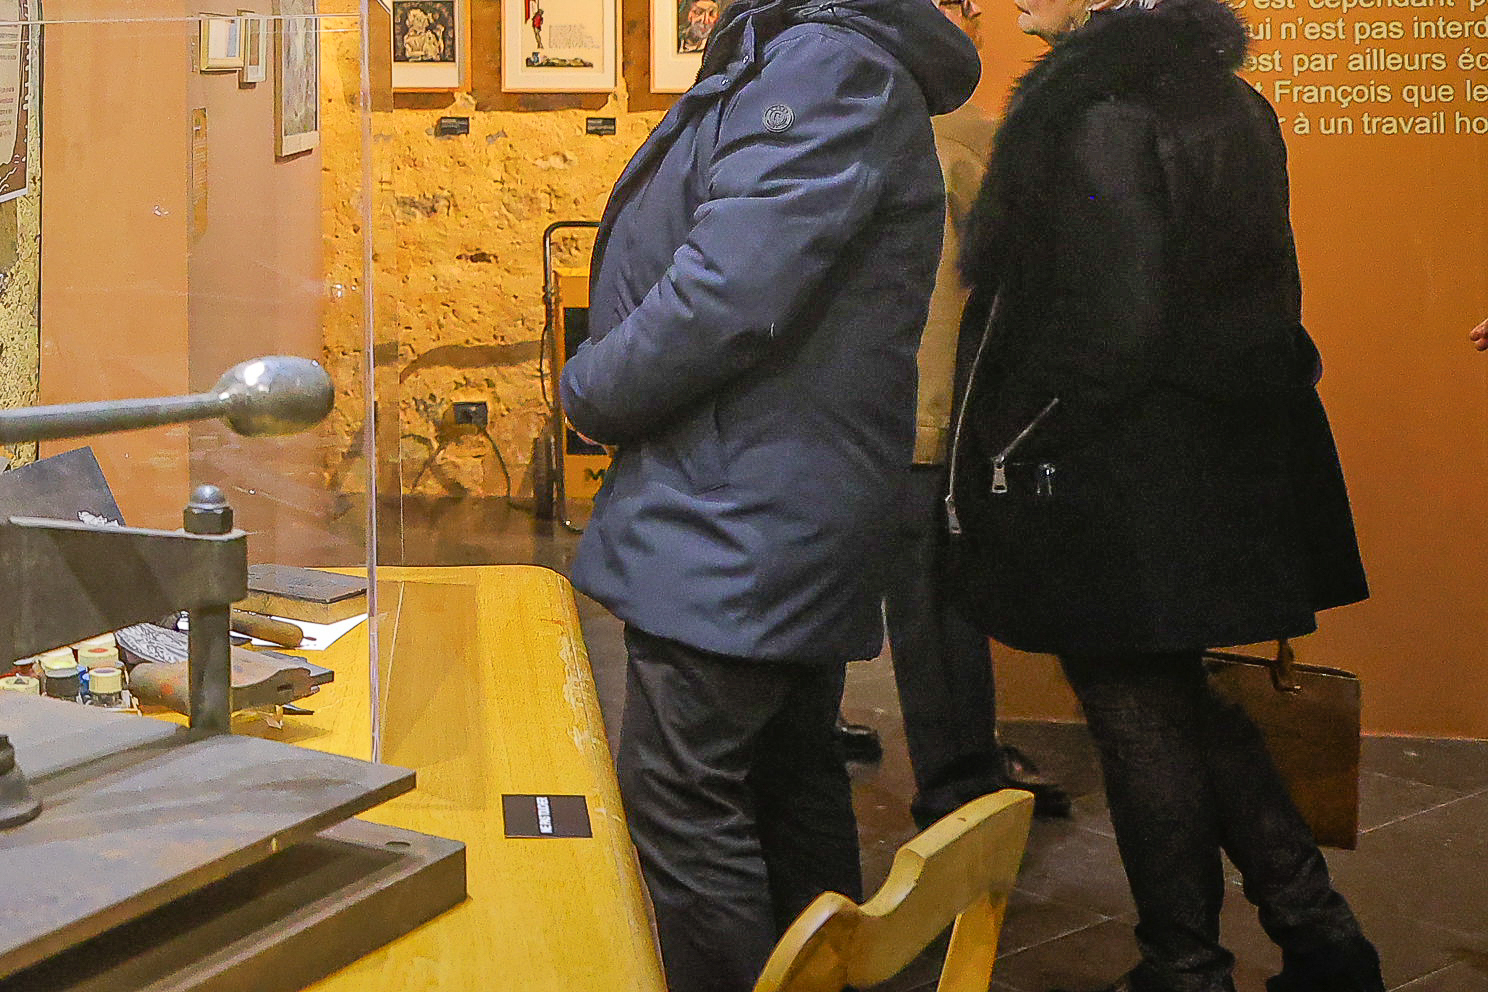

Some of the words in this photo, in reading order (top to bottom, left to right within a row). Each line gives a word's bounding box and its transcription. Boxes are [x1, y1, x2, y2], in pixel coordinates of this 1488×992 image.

[1248, 16, 1272, 40] ui
[1280, 17, 1346, 40] n'est
[1354, 20, 1405, 44] pas
[1413, 14, 1488, 39] interd
[1293, 52, 1338, 77] par
[1348, 48, 1447, 71] ailleurs
[1457, 47, 1488, 71] éc
[1274, 80, 1392, 108] François
[1402, 84, 1455, 108] que
[1293, 111, 1311, 135] à
[1319, 115, 1354, 135] un
[1362, 111, 1446, 135] travail
[1455, 111, 1488, 135] ho
